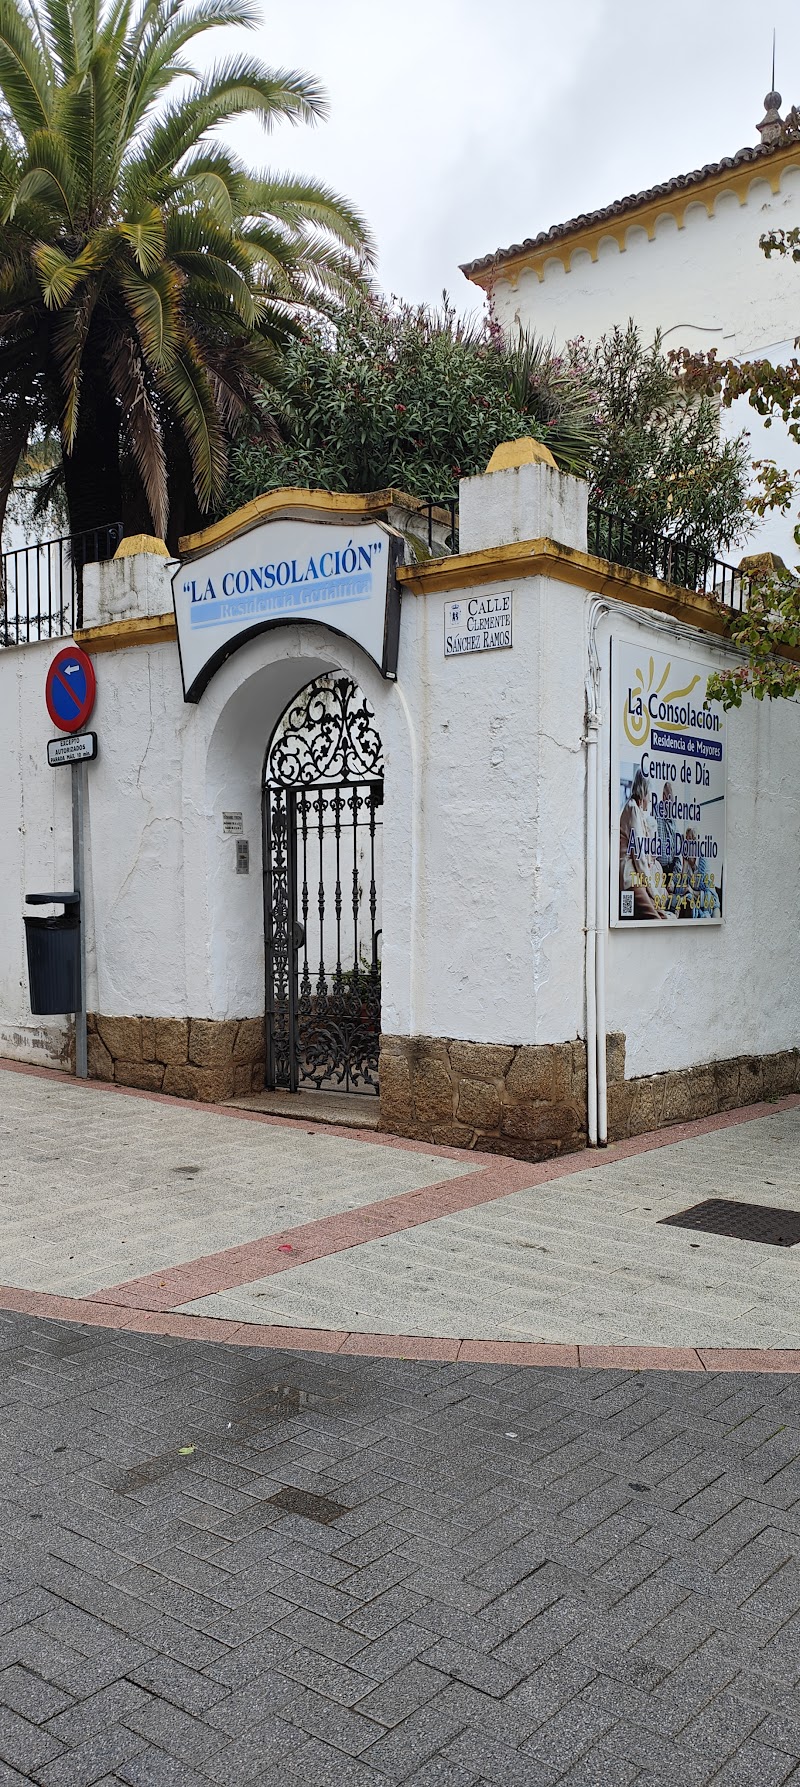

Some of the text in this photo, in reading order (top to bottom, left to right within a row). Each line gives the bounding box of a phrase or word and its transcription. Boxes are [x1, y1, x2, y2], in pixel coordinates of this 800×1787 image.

[219, 592, 295, 618] Residencia
[468, 596, 510, 616] CALLE
[467, 614, 511, 632] CLEMENTE
[446, 630, 510, 654] SÁNCHEZ RAMOS
[628, 687, 720, 732] La Consolación
[55, 744, 86, 755] AUTORIZADOS
[60, 738, 80, 747] EXCEPTO
[652, 732, 721, 757] Residencia de Mayores
[640, 752, 710, 787] Centro de Día
[650, 792, 701, 822] Residencia
[627, 827, 718, 860] Ayuda a Domicilio
[654, 872, 673, 889] 927
[676, 873, 688, 889] 22
[690, 873, 701, 889] 47
[703, 874, 715, 889] 42
[654, 894, 673, 910] 927
[675, 894, 688, 911] 24
[689, 895, 701, 911] 66
